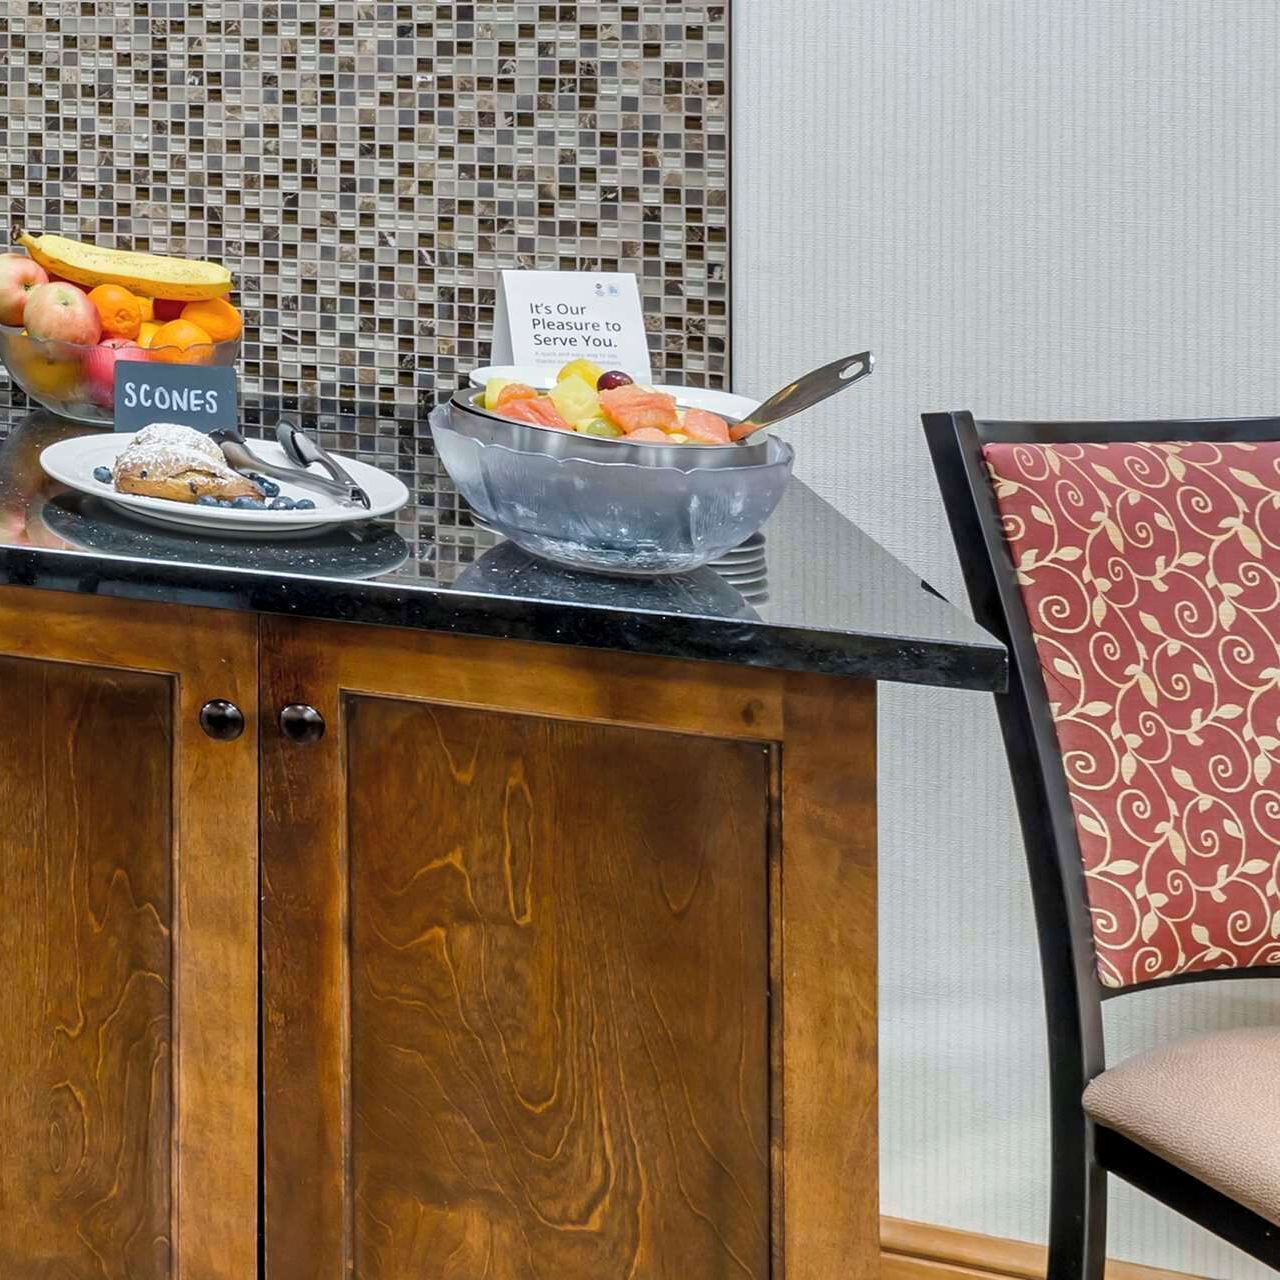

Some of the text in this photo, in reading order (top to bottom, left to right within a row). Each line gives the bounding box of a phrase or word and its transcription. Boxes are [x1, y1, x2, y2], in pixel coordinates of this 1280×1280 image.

[529, 302, 586, 315] It's Our
[532, 318, 622, 332] Pleasure to
[533, 333, 618, 348] Serve You.
[124, 381, 218, 414] SCONES
